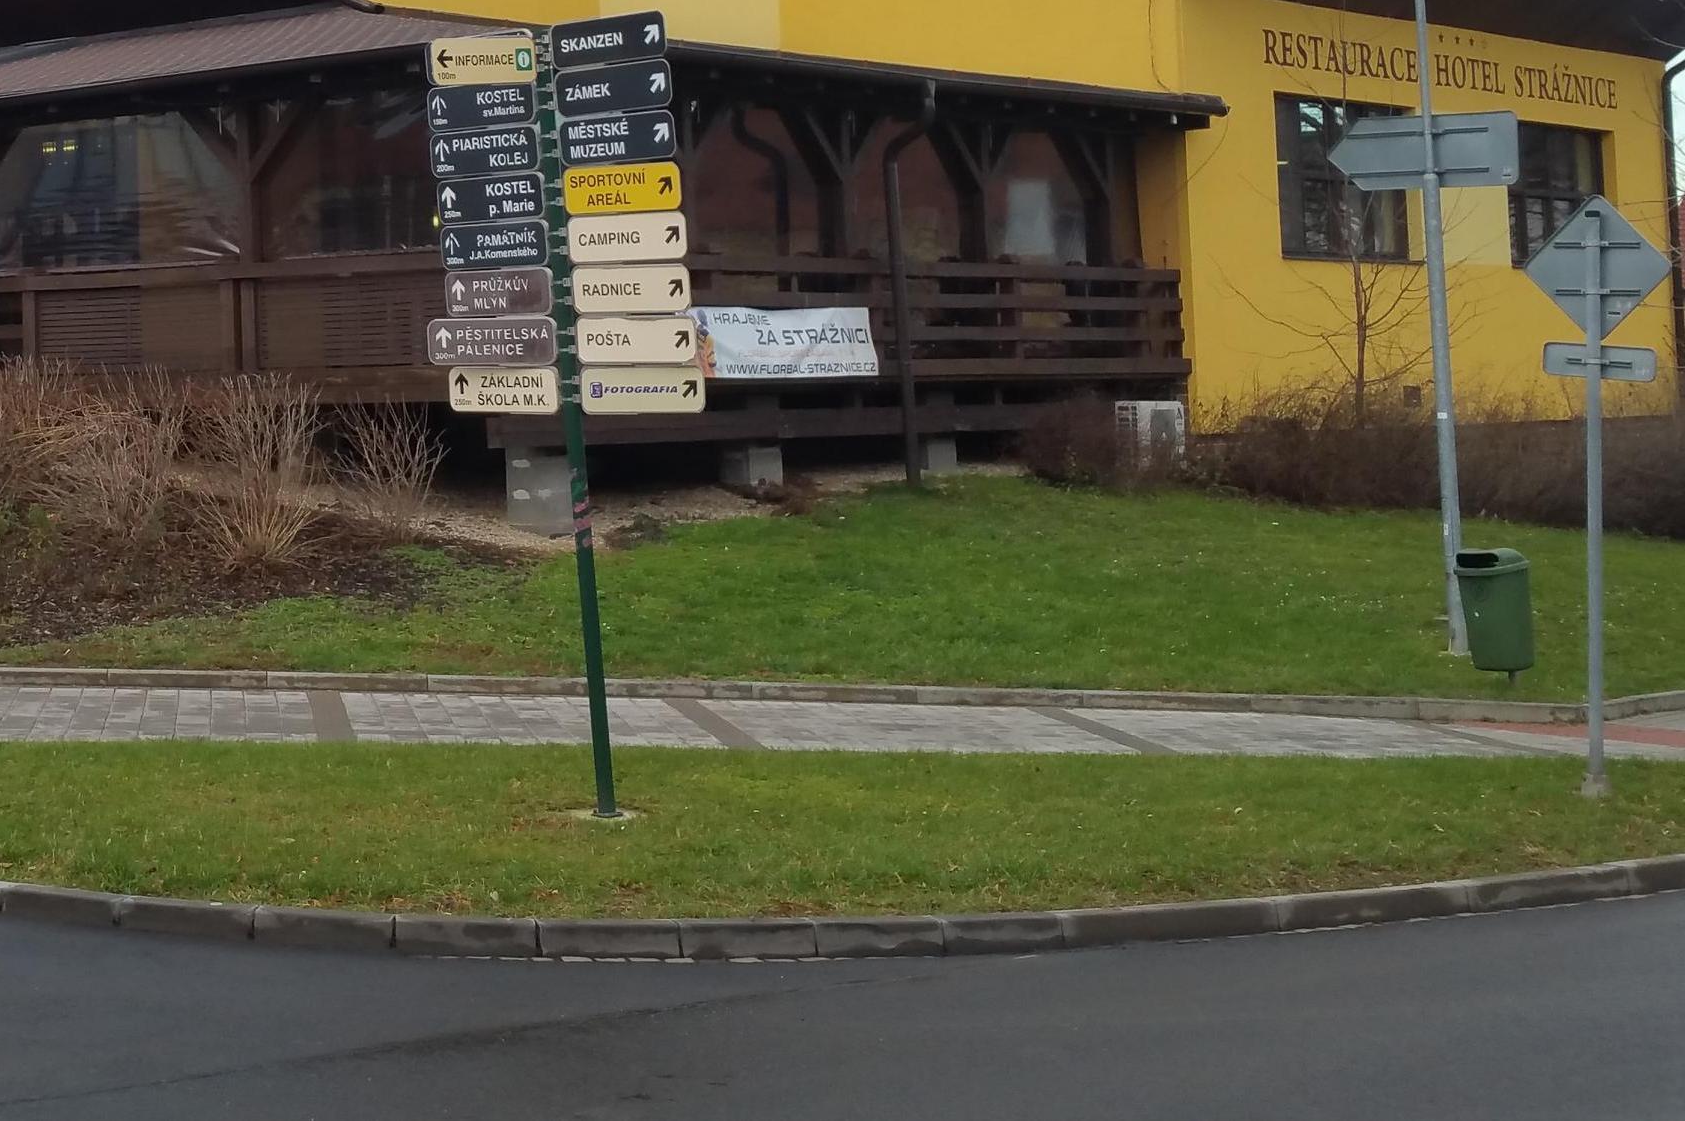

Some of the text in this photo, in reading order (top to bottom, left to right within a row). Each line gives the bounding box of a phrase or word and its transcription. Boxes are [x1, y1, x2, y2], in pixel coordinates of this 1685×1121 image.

[560, 32, 624, 54] SKANZEN
[455, 53, 515, 67] INFORMACE
[437, 72, 457, 80] 100m
[1263, 29, 1620, 110] RESTAURACE HOTEL STRÁŽNICE
[476, 89, 524, 106] KOSTEL
[565, 83, 611, 102] ZÁMEK
[482, 105, 526, 118] sv.Martina
[568, 118, 629, 140] MĚSTSKÉ
[452, 129, 528, 152] PIARISTICKÁ
[570, 142, 626, 159] MUZEUM
[489, 152, 529, 167] KOLEJ
[570, 168, 646, 189] SPORTOVNÍ
[485, 180, 535, 197] KOSTEL
[587, 191, 631, 207] AREÁL
[489, 199, 535, 217] p. Marie
[476, 226, 537, 247] PAMÁTNÍK
[578, 231, 641, 247] CAMPING
[469, 246, 538, 261] J.A.Komenského
[582, 283, 641, 296] RADNICE
[474, 293, 507, 310] MLÝN
[456, 325, 549, 341] PĚSTITELSKÁ
[586, 331, 631, 346] POŠTA
[756, 328, 779, 346] ZA
[435, 352, 456, 360] 300m
[457, 342, 524, 356] PÁLENICE
[480, 374, 543, 388] ZÁKLADNÍ
[604, 385, 678, 394] FOTOGRAFIA
[477, 391, 550, 407] ŠKOLA M.K.
